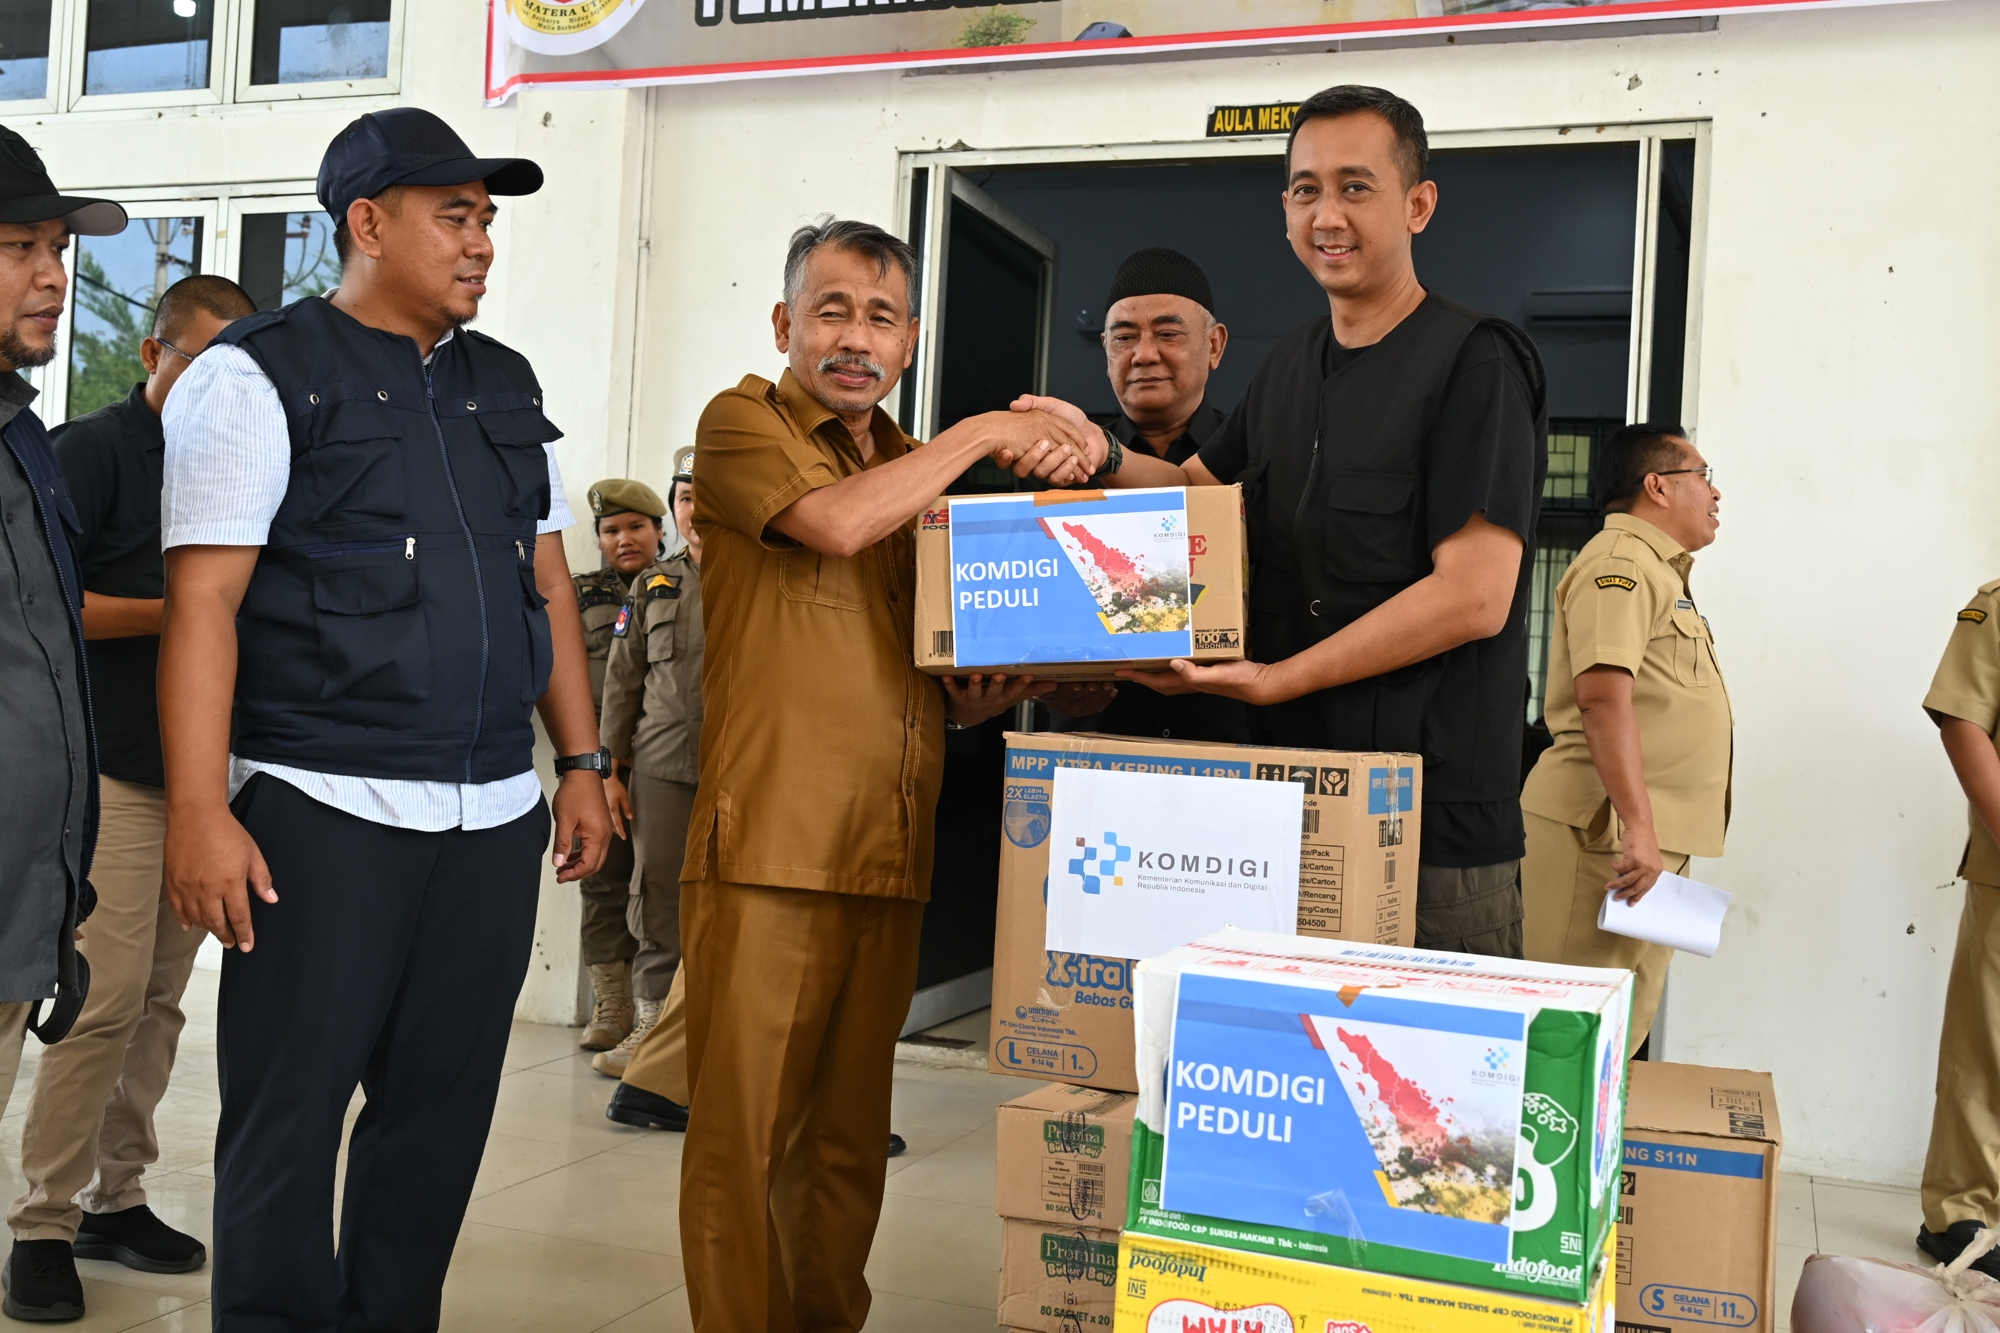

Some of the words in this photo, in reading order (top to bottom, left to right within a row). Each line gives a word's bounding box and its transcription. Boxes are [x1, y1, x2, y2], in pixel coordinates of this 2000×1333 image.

[532, 14, 560, 25] Berkarya
[569, 14, 588, 24] Hidup
[537, 22, 555, 31] Mulia
[556, 20, 591, 31] Berbudaya
[1214, 108, 1254, 132] AULA
[956, 558, 1058, 582] KOMDIGI
[960, 588, 1039, 610] PEDULI
[1195, 633, 1226, 643] 100%
[1012, 756, 1049, 771] MPP
[1007, 787, 1023, 798] 2X
[1138, 851, 1268, 878] KOMDIGI
[1138, 874, 1182, 884] Kementerian
[1184, 878, 1226, 887] Komunikasi
[1244, 882, 1267, 891] Digital
[1138, 882, 1168, 891] Republik
[1170, 886, 1205, 894] Indonesia
[1075, 991, 1116, 1007] Bebas
[1028, 1006, 1059, 1017] unicharm
[1008, 1022, 1036, 1031] Uni-Charm
[1037, 1024, 1064, 1034] Indonesia
[1008, 1041, 1022, 1064] L
[1026, 1046, 1058, 1058] CELANA
[1046, 1060, 1054, 1068] kg
[1071, 1054, 1077, 1070] 1
[1176, 1060, 1325, 1106] KOMDIGI
[1471, 1070, 1520, 1082] KOMDIGI
[1177, 1102, 1292, 1143] PEDULI
[1654, 1150, 1697, 1166] S11N
[1056, 1205, 1080, 1214] SACHET
[1169, 1212, 1182, 1220] oleh
[1138, 1216, 1146, 1224] PT
[1149, 1218, 1190, 1232] INDOFOOD
[1191, 1224, 1208, 1235] CBP
[1209, 1227, 1238, 1240] SUKSES
[1239, 1232, 1275, 1246] MAKMUR
[1278, 1237, 1292, 1248] Tbk
[1299, 1240, 1328, 1253] Indonesia
[1560, 1236, 1581, 1252] SNI
[1046, 1239, 1115, 1267] Promina
[1087, 1266, 1116, 1286] Bayi
[1130, 1255, 1208, 1282] Indofood
[1362, 1288, 1392, 1298] Indonesia
[1399, 1293, 1414, 1302] Tbk
[1652, 1288, 1665, 1311] S
[1673, 1293, 1710, 1306] CELANA
[1418, 1296, 1455, 1308] MAKMUR
[1458, 1301, 1489, 1313] SUKSES
[1041, 1306, 1051, 1316] 80
[1054, 1308, 1089, 1321] SACHET
[1098, 1315, 1110, 1326] 20
[1492, 1306, 1510, 1315] CBP
[1512, 1309, 1560, 1324] INDOFOOD
[1694, 1307, 1702, 1316] kg
[1721, 1301, 1736, 1319] 11
[1563, 1317, 1573, 1325] PT
